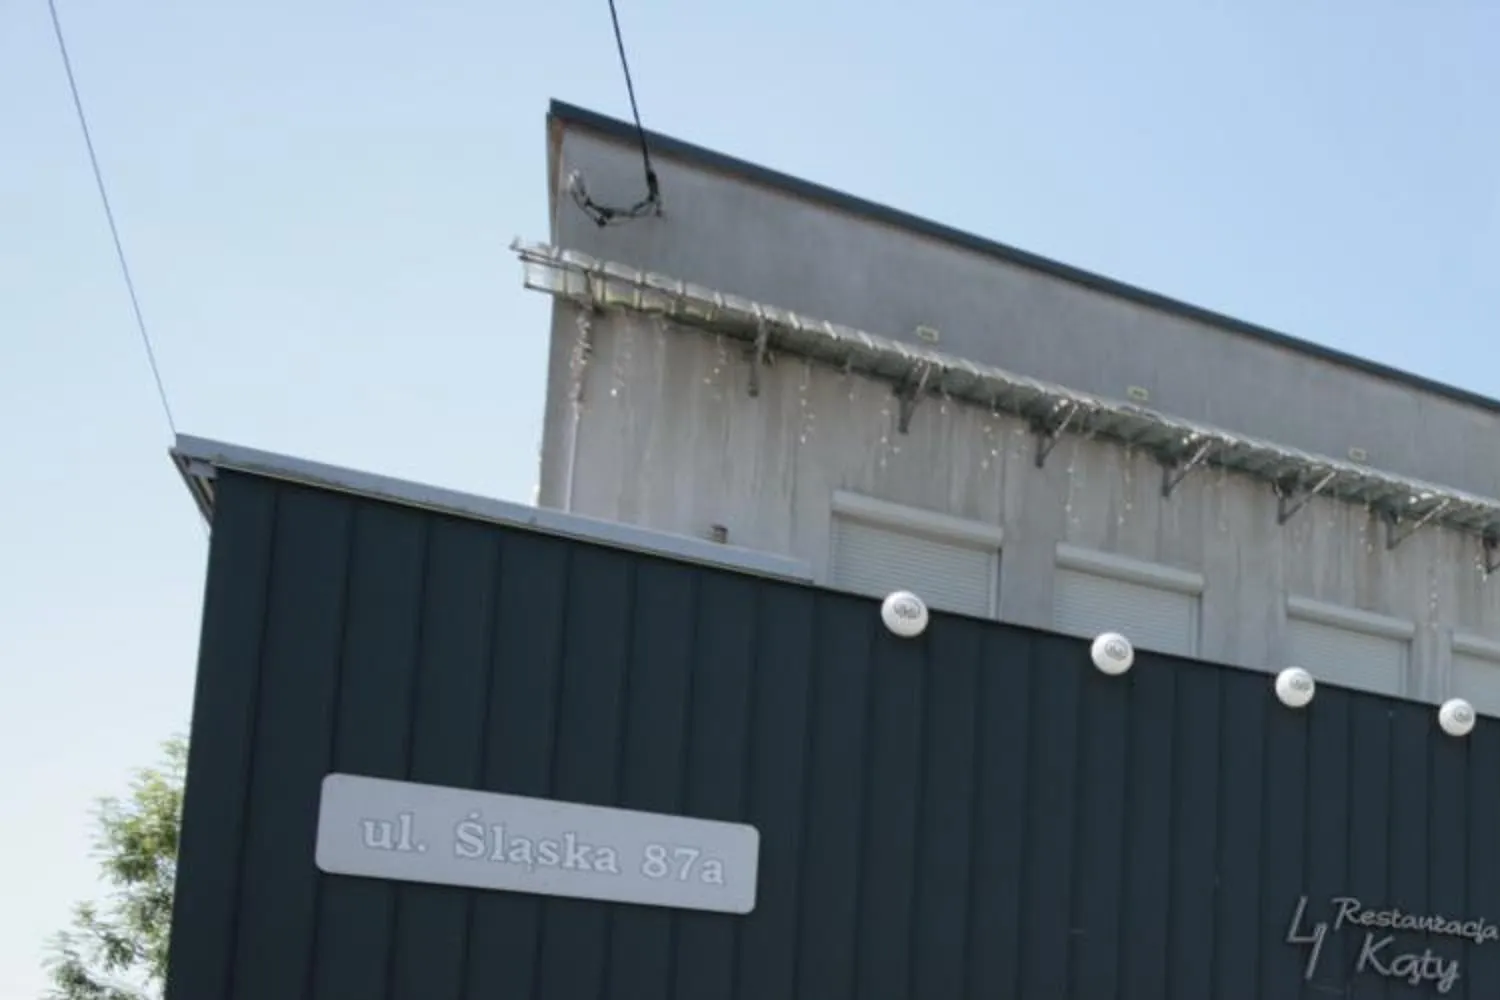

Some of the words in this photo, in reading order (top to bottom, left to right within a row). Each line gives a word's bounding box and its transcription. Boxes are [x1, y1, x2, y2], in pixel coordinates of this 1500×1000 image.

[362, 813, 427, 853] ul.
[454, 812, 620, 872] Śląska
[641, 844, 726, 886] 87a
[1331, 896, 1499, 945] Restauracja
